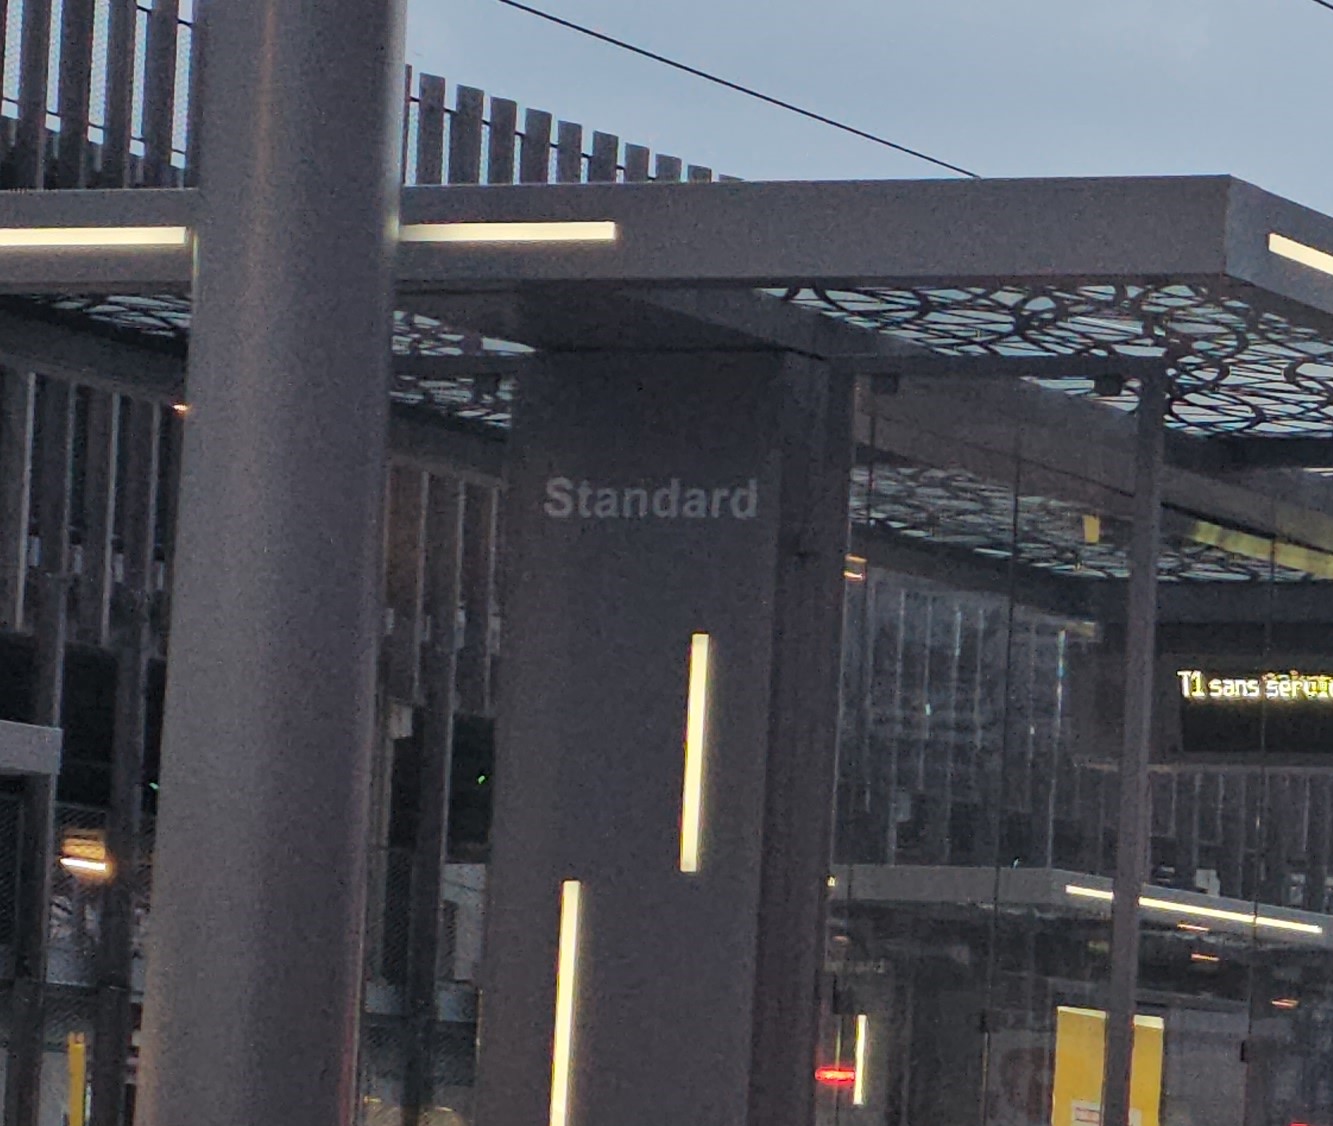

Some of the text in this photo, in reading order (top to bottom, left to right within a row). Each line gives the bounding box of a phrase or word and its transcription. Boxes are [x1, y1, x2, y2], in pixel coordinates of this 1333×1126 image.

[544, 476, 759, 520] Standard
[1177, 670, 1205, 698] T1
[1208, 678, 1260, 698] sans
